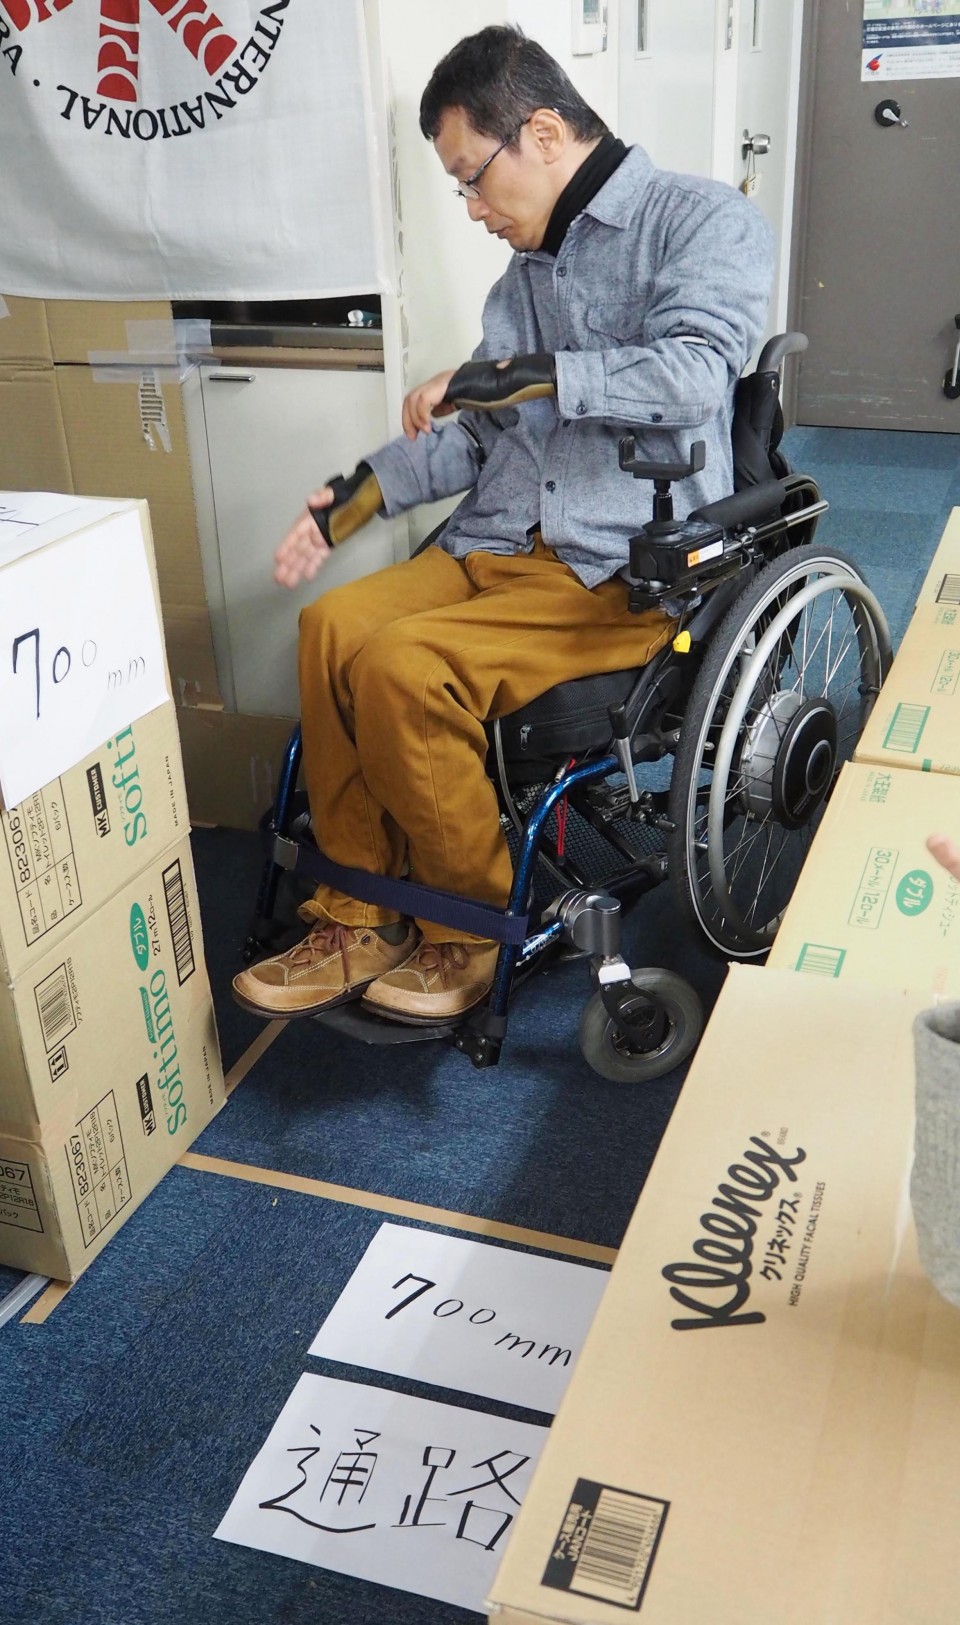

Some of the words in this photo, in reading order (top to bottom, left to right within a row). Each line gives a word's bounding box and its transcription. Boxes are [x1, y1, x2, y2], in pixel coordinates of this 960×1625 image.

[90, 767, 104, 810] CUSTOMER
[164, 754, 172, 788] JAPAN
[8, 806, 31, 884] 823067
[94, 811, 112, 837] MK
[902, 876, 927, 908] ダブル
[150, 969, 187, 1135] Softimo
[69, 1134, 90, 1197] 823067
[811, 1181, 826, 1212] TISSUES
[661, 1136, 807, 1331] Kleenex
[760, 1198, 800, 1281] クリネックス
[804, 1214, 819, 1243] FACIAL
[795, 1245, 811, 1282] QUALITY
[789, 1284, 803, 1307] HIGH
[384, 1272, 573, 1368] 700mm
[259, 1423, 532, 1552] 通路
